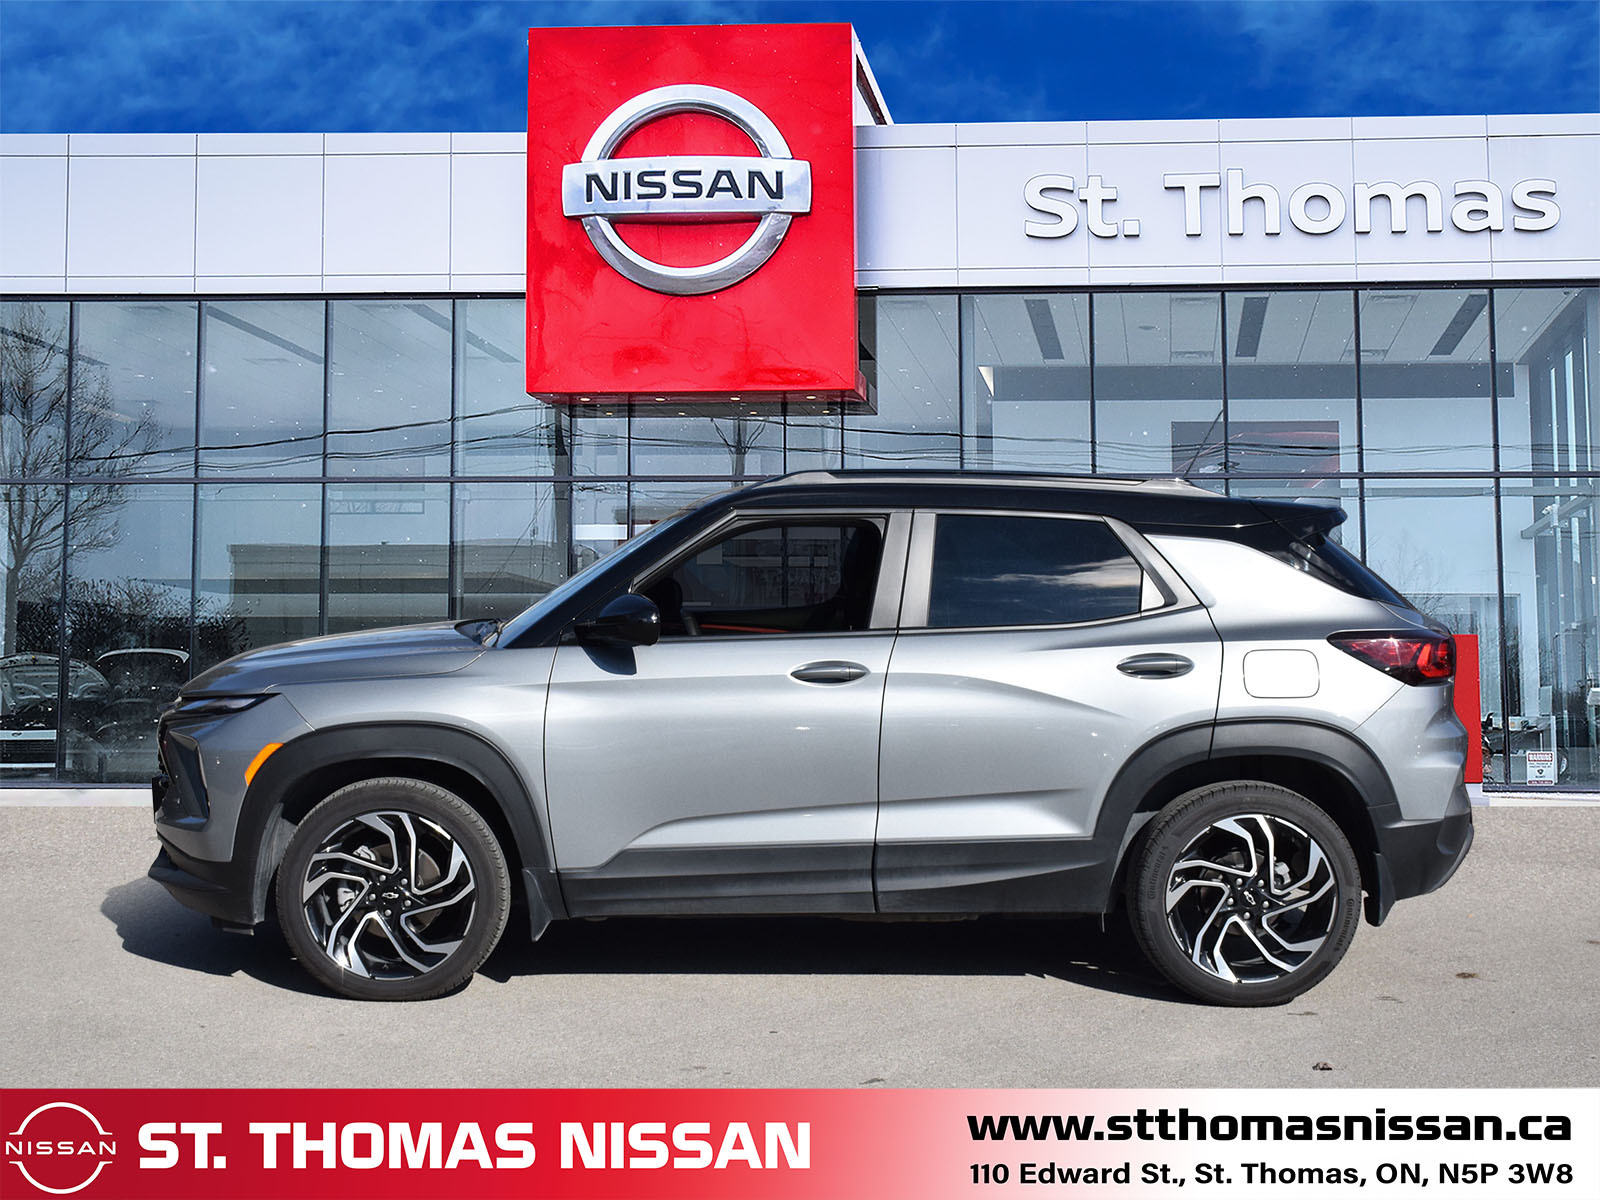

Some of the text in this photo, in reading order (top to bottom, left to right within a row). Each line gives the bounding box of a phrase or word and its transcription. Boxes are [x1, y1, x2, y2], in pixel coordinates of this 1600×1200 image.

[585, 170, 784, 202] NISSAN
[1023, 168, 1562, 239] St. Thomas
